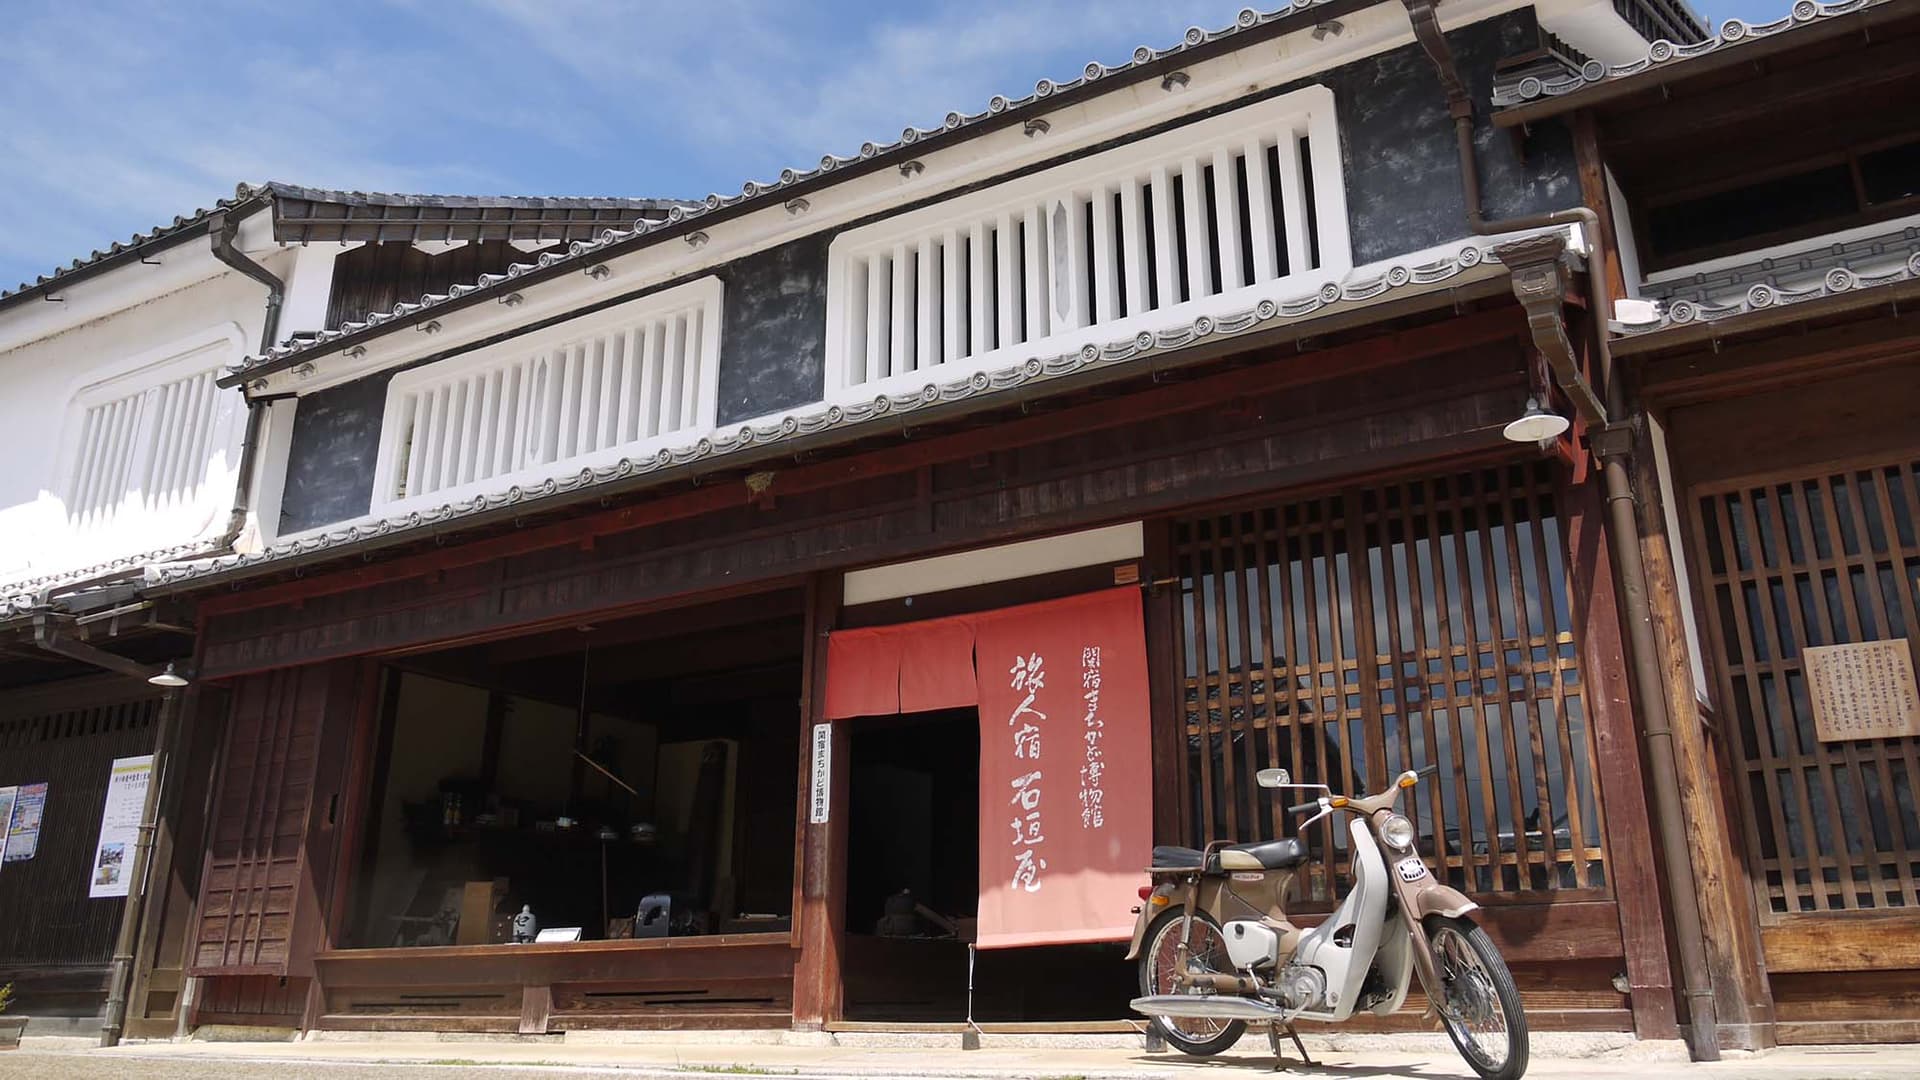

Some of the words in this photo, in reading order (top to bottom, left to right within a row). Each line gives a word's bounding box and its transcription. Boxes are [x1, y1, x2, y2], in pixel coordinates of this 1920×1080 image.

[1009, 652, 1047, 760] 旅人宿
[814, 730, 827, 818] 関宿まちかど博物館
[1009, 770, 1047, 893] 石垣屋
